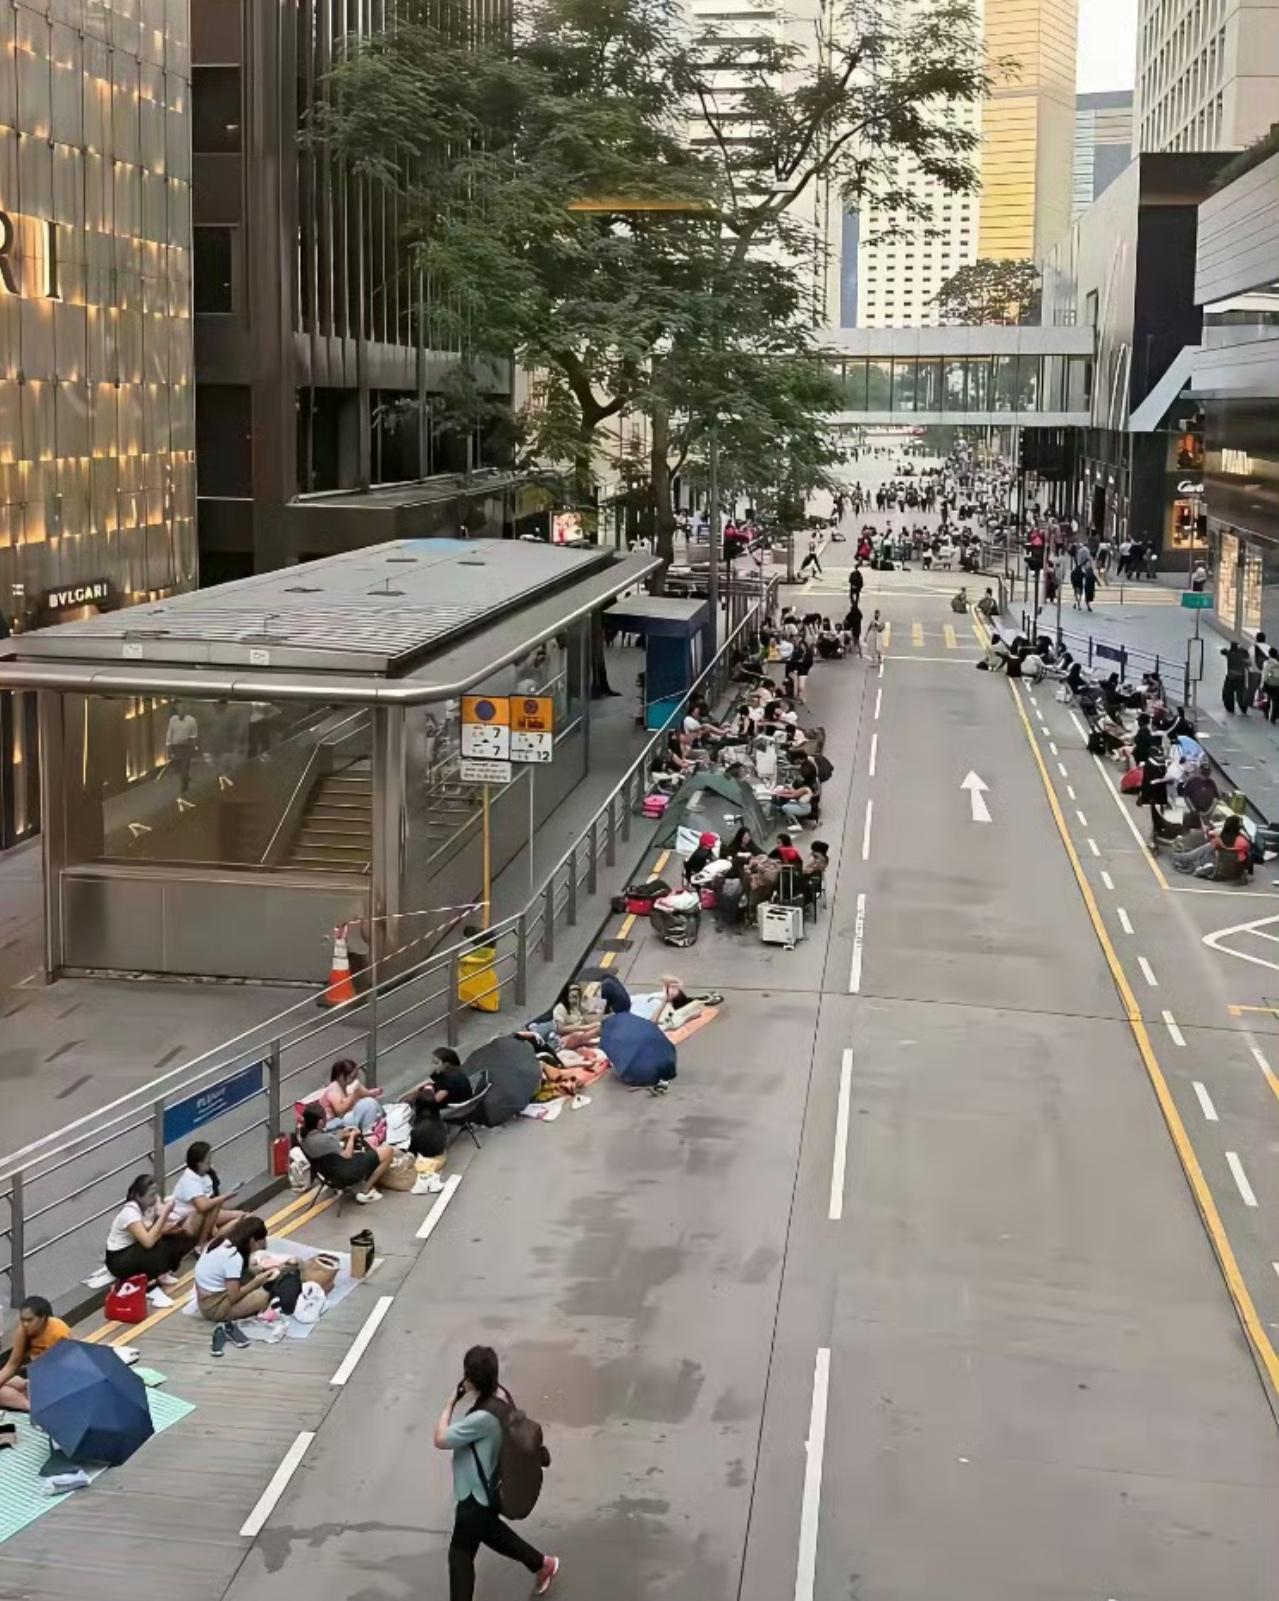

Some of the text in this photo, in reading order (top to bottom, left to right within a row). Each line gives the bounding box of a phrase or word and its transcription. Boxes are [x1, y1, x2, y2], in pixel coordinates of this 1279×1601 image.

[48, 583, 107, 608] BVLGARI
[492, 727, 500, 738] 7
[537, 734, 544, 744] 7
[492, 746, 500, 757] 7
[536, 751, 550, 760] 12
